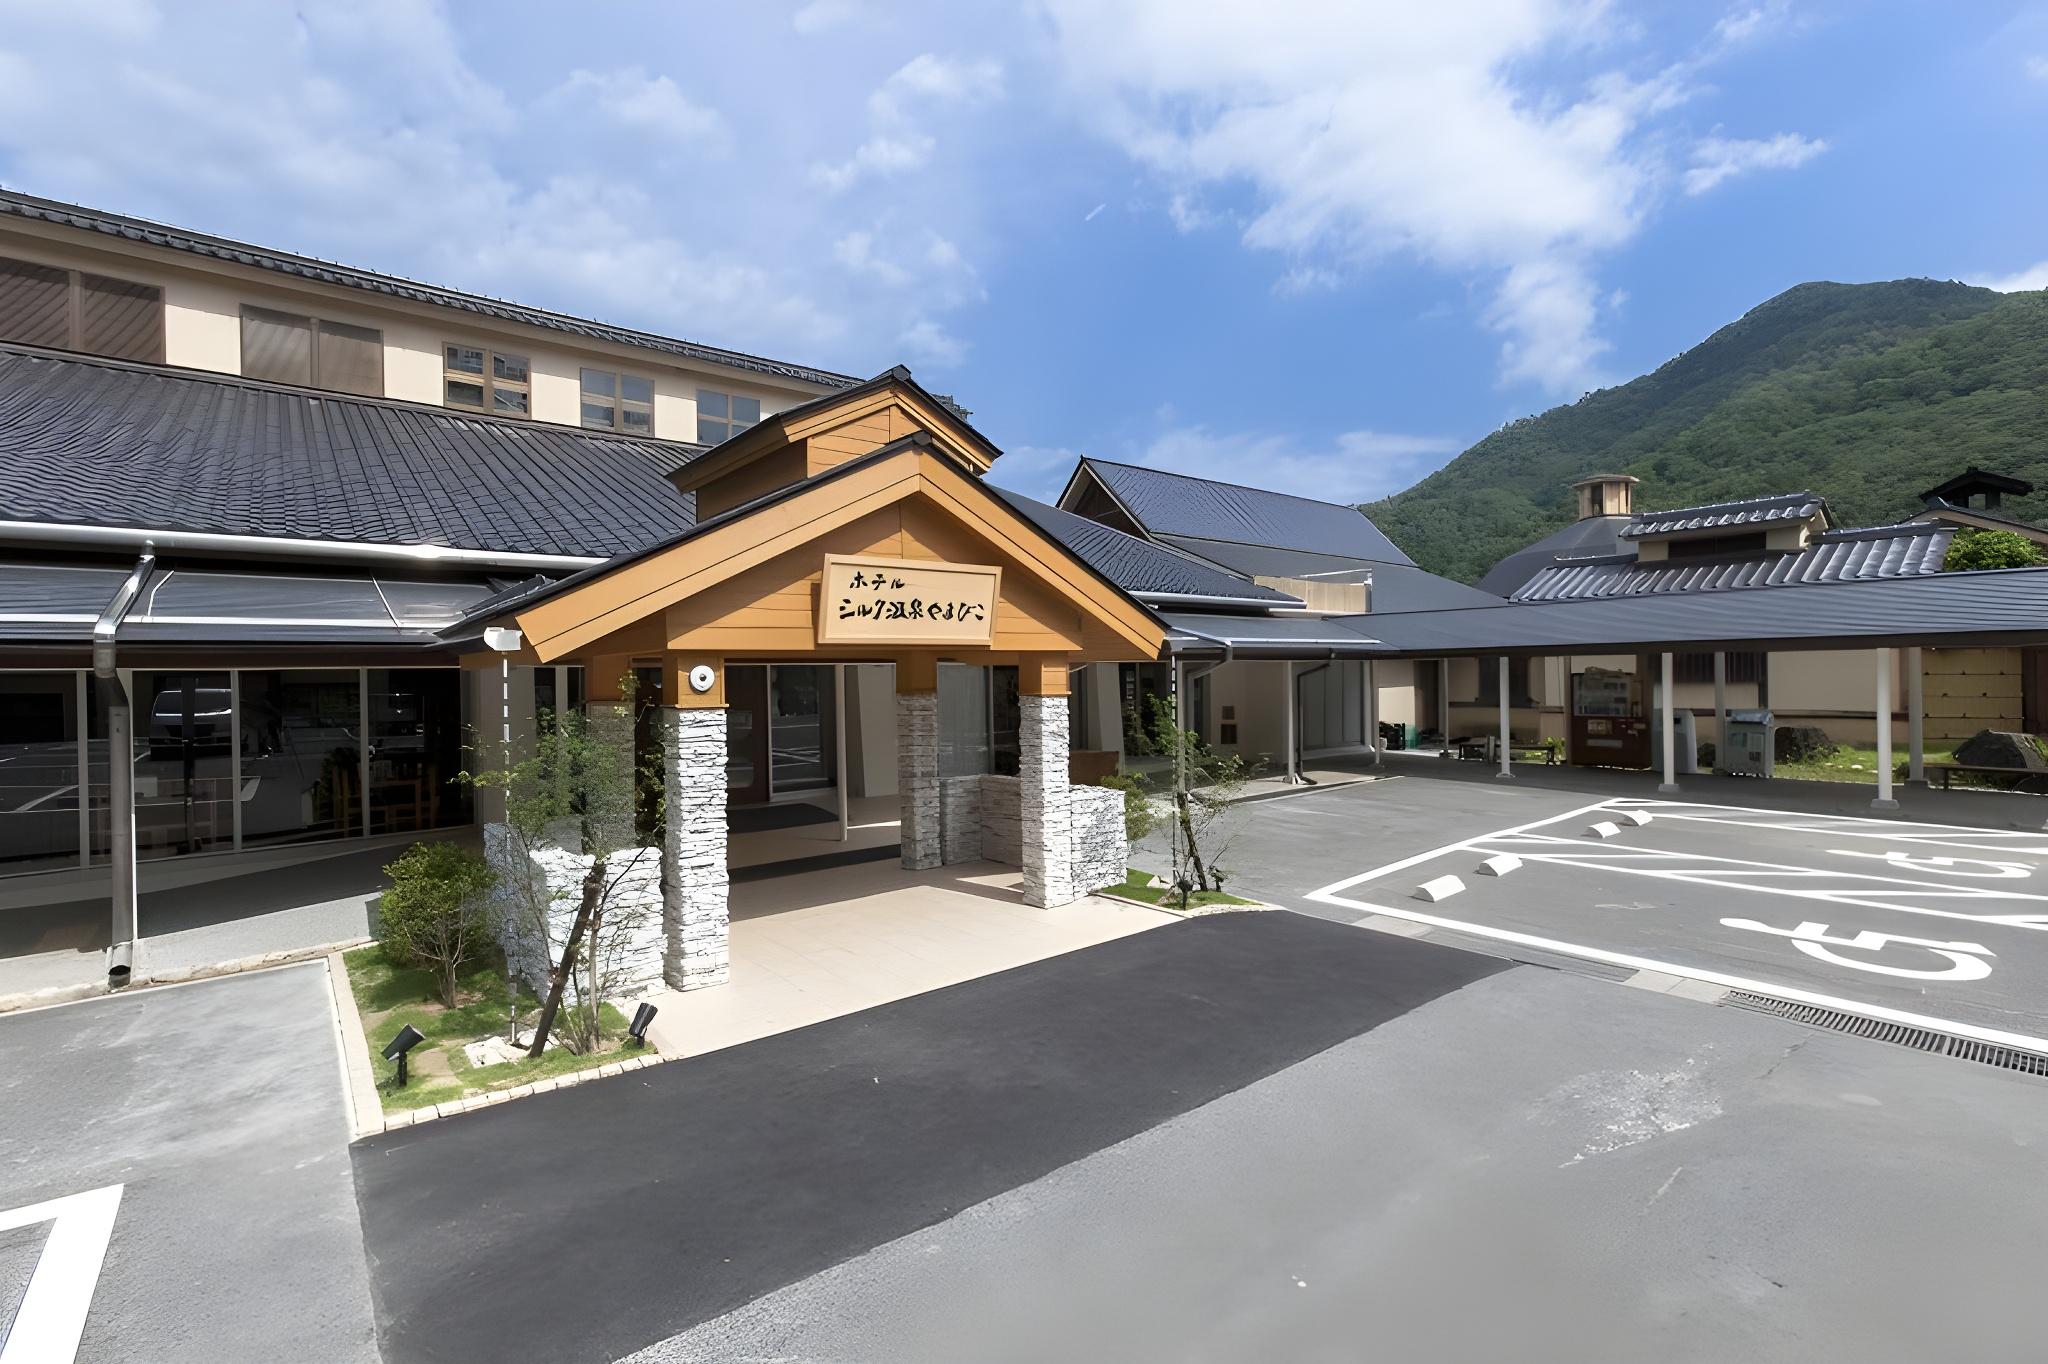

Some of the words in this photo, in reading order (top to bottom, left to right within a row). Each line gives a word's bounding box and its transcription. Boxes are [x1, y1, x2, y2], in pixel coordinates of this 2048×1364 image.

[850, 571, 905, 590] ホテル
[839, 598, 984, 621] シルク温泉やまびこ
